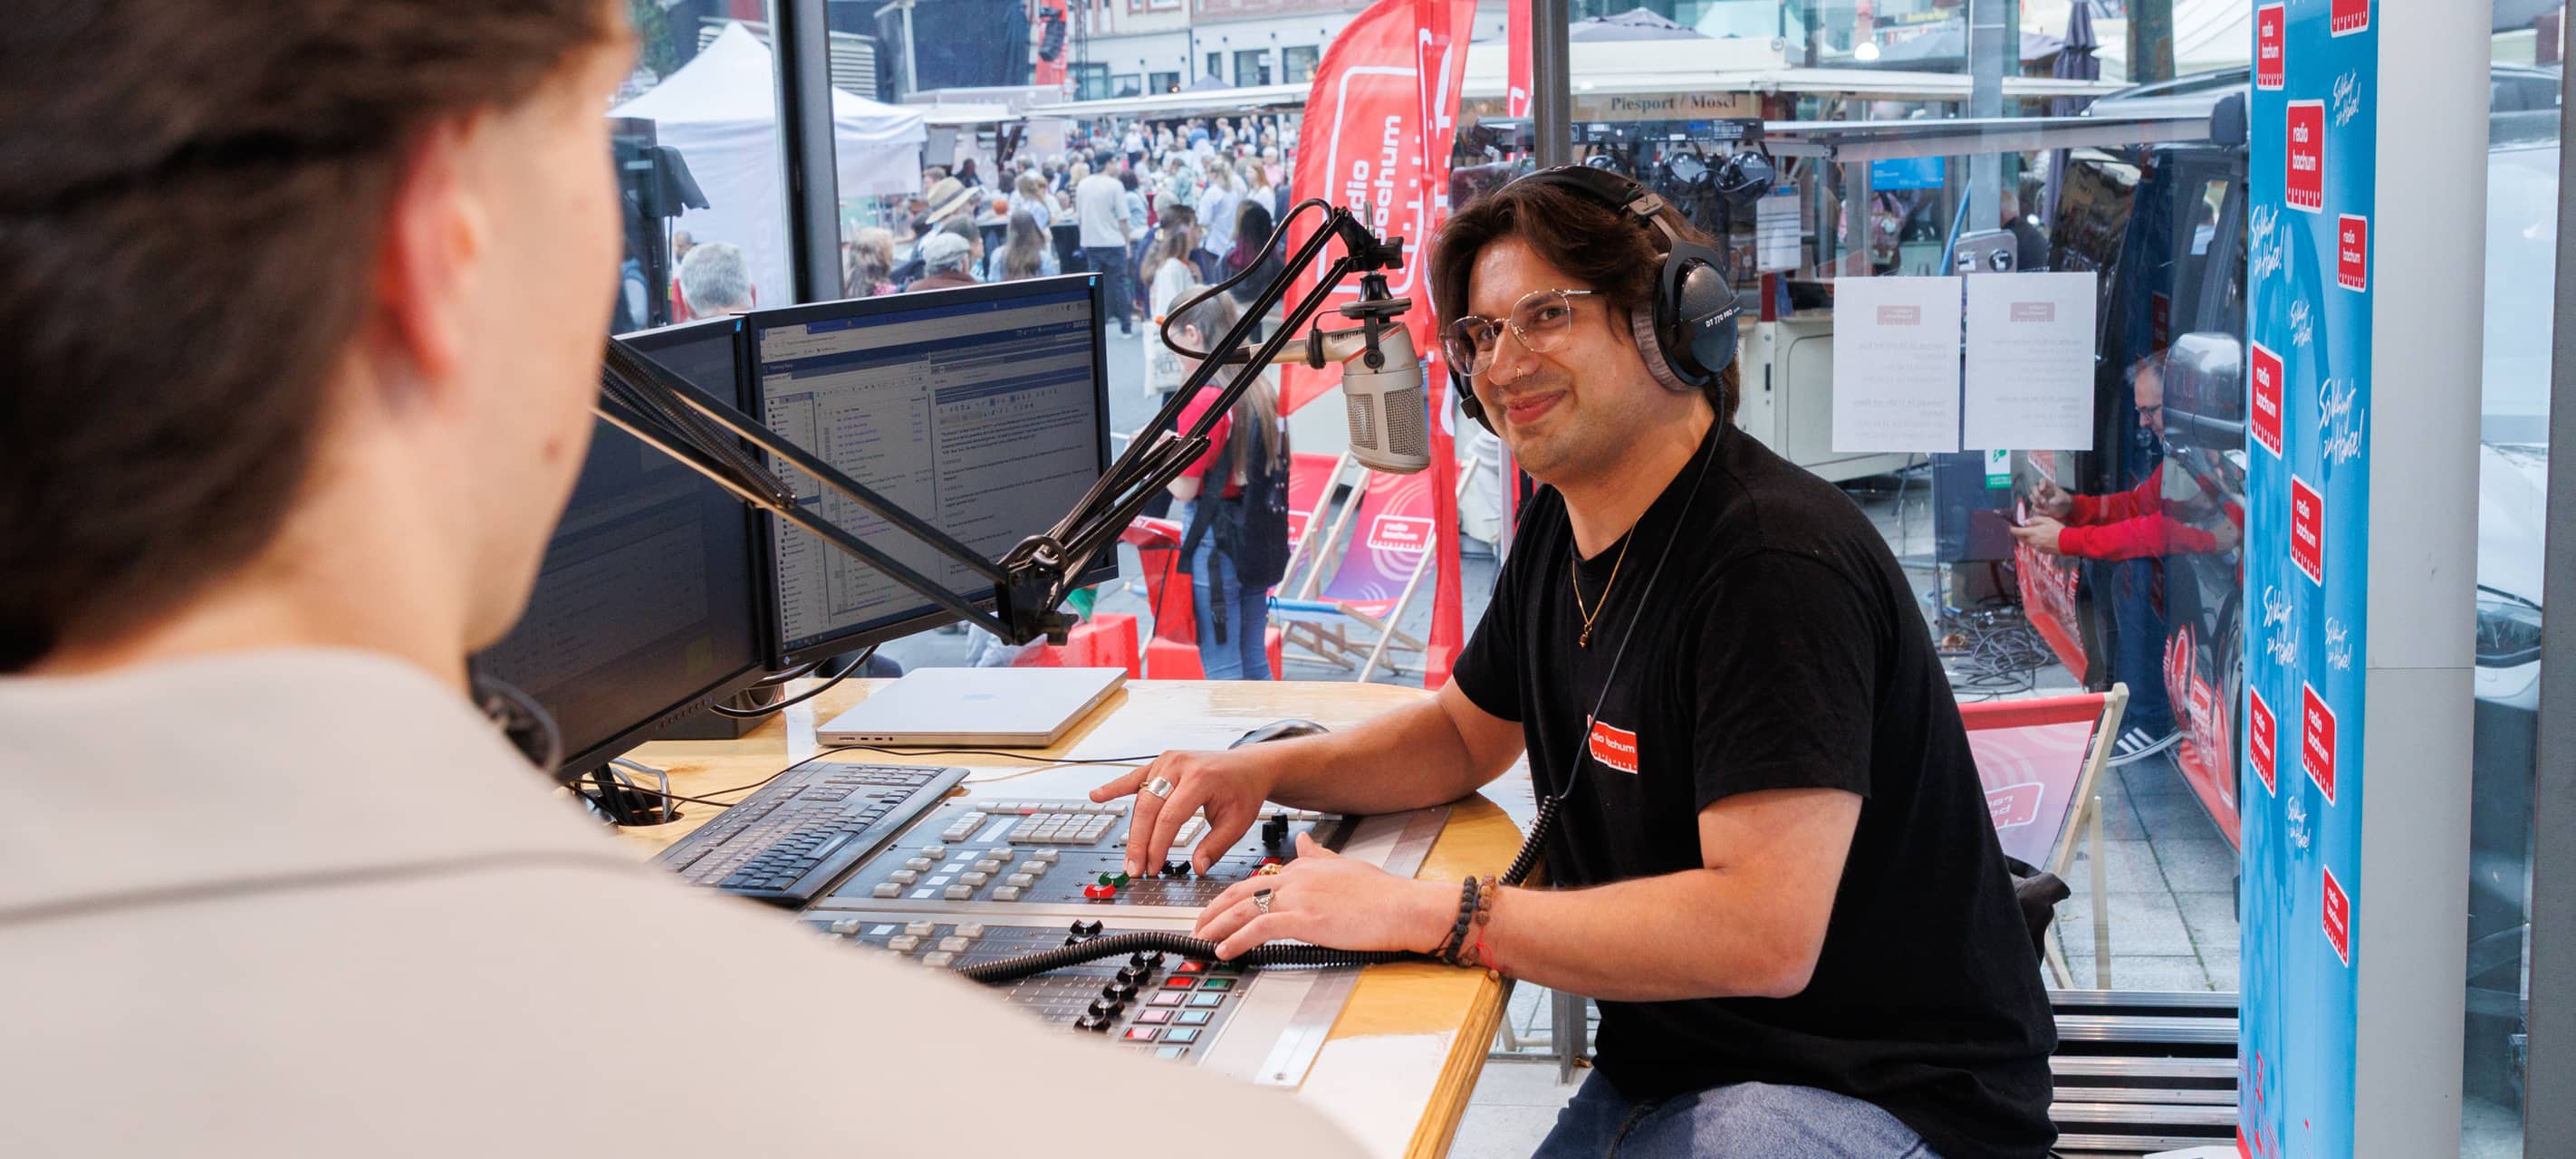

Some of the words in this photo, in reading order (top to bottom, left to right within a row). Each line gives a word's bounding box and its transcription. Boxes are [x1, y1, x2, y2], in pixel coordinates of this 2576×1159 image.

[2262, 21, 2273, 37] radio
[2261, 43, 2279, 59] bochum
[1611, 95, 1674, 114] Piesport
[2292, 121, 2309, 143] radio
[2292, 148, 2316, 171] bochum
[1345, 159, 1370, 226] adio
[2342, 229, 2355, 244] radio
[2342, 247, 2360, 263] bochum
[2256, 367, 2270, 388] radio
[2255, 387, 2275, 418] bochum
[2296, 499, 2310, 520] radio
[2295, 517, 2316, 549] bochum
[2254, 709, 2265, 733] radio
[2308, 708, 2322, 733] radio
[1606, 734, 1635, 753] bchum
[2254, 725, 2271, 761] bochum
[2308, 725, 2329, 765] bochum
